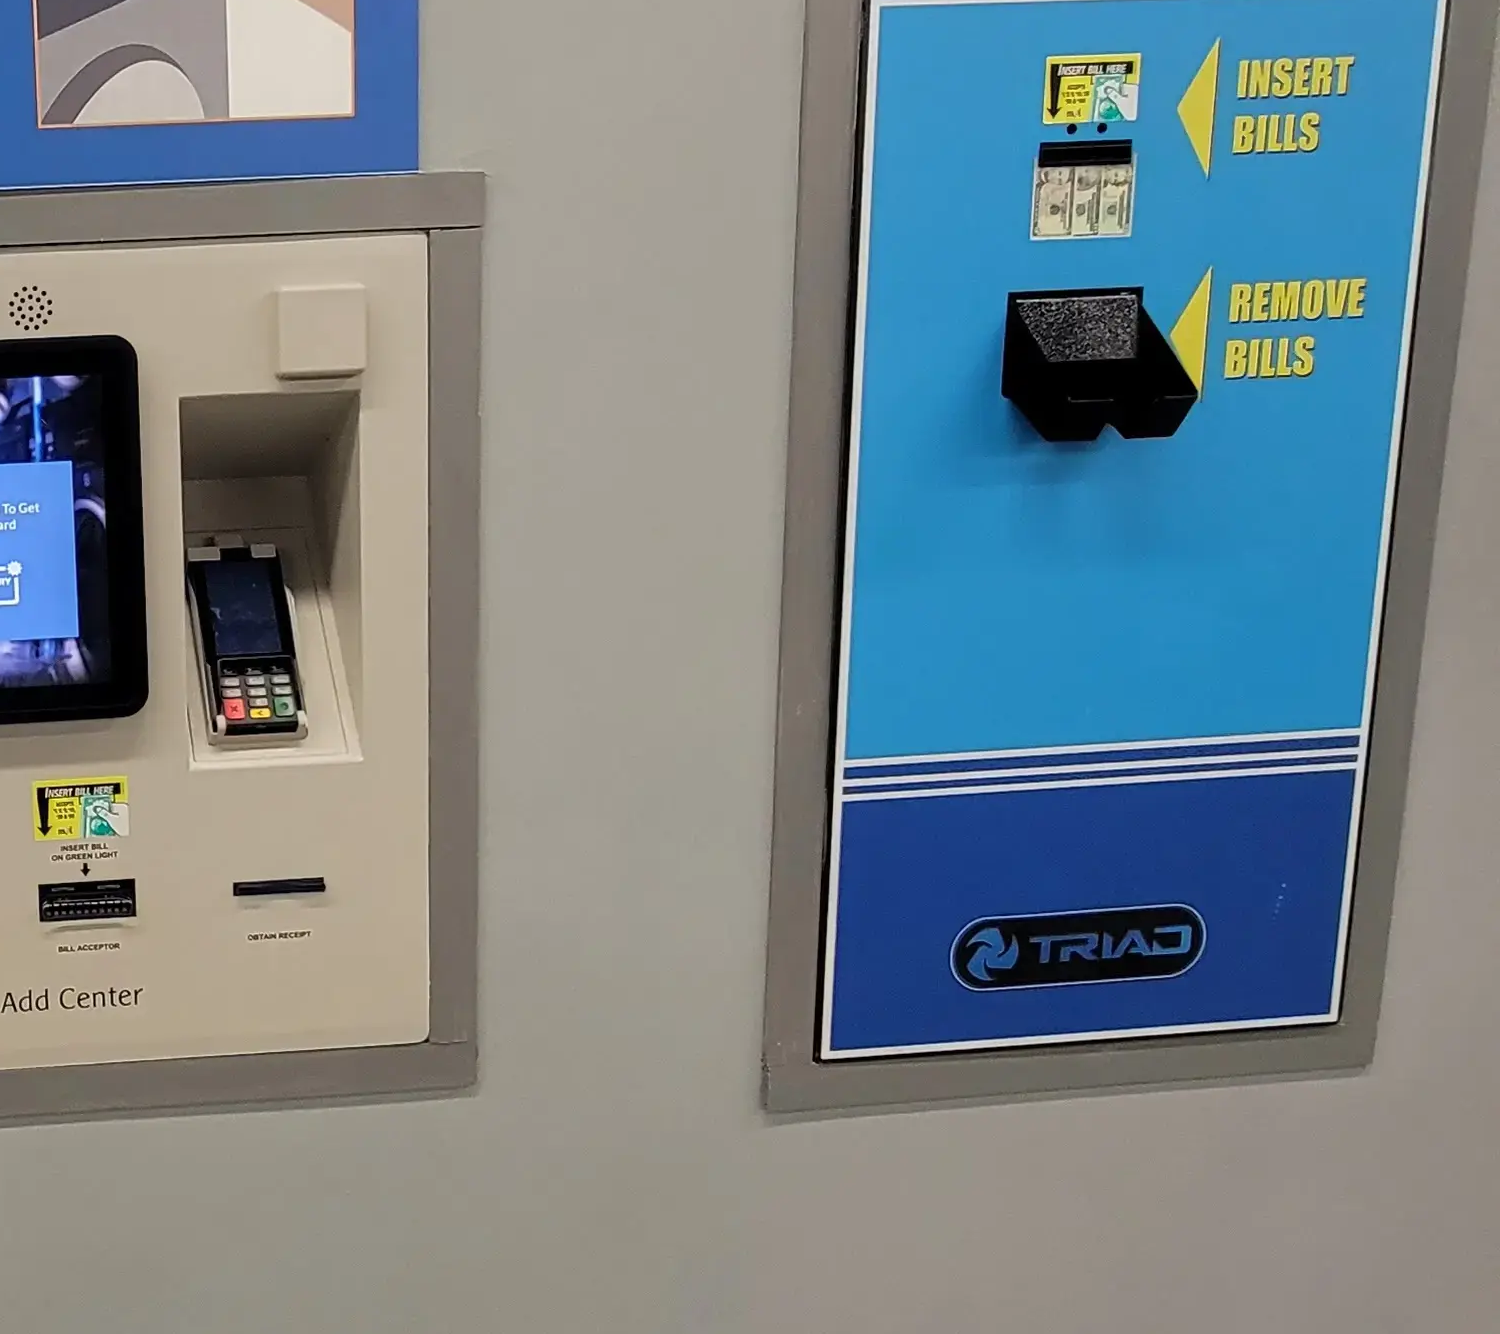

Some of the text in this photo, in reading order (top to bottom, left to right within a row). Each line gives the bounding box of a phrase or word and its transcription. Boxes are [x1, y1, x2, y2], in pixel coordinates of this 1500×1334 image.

[1236, 55, 1356, 100] INSERT
[1231, 113, 1321, 156] BILLS
[1227, 277, 1367, 325] REMOVE
[1223, 335, 1315, 380] BILLS
[1, 502, 17, 515] To
[18, 502, 41, 514] Get
[44, 787, 73, 799] INSERT
[51, 850, 119, 862] ON GREEN LIGHT
[60, 842, 109, 852] INSERT BILL
[246, 929, 312, 942] OBTAIN RECEIPT
[1029, 924, 1193, 964] TRIAD
[57, 942, 121, 953] BILL ACCEPTOR
[0, 987, 50, 1014] Add
[59, 984, 145, 1010] Center
